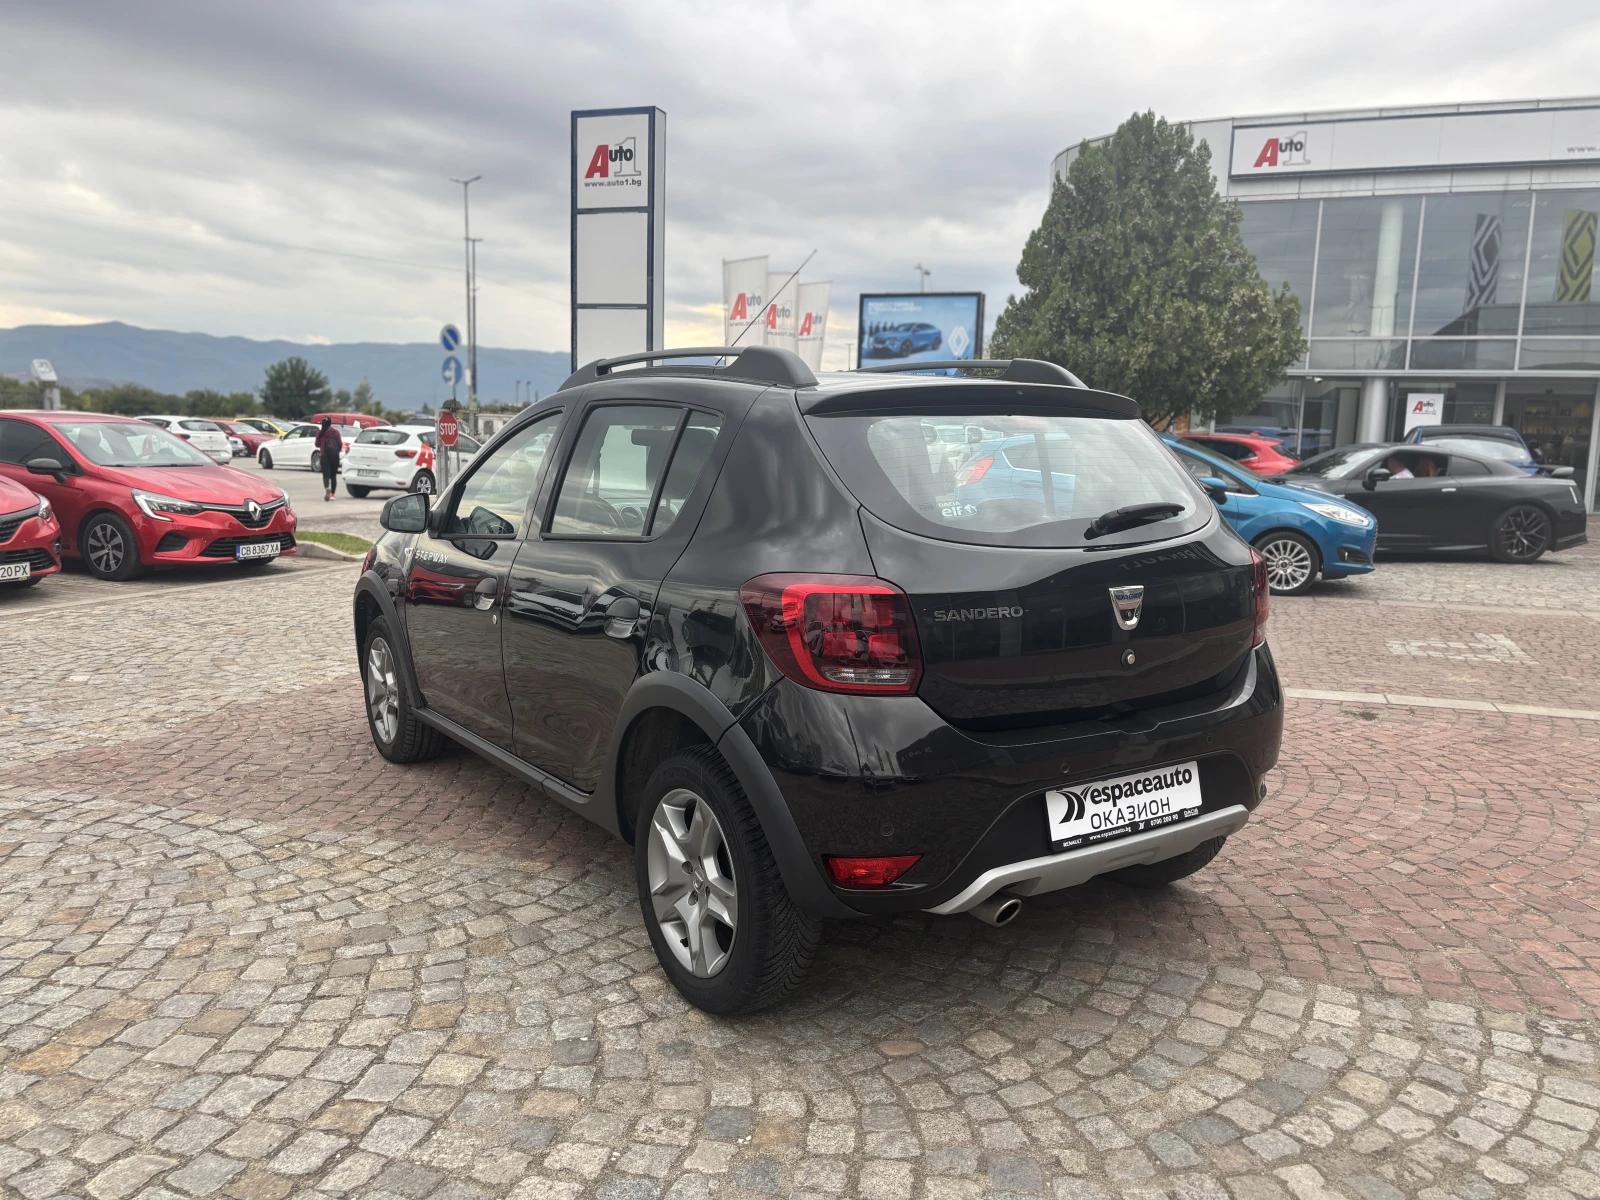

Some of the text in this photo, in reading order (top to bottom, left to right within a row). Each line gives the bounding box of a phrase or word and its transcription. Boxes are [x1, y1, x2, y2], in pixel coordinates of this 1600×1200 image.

[584, 178, 642, 188] www.auto1.bg
[439, 422, 457, 436] STOP
[941, 505, 964, 517] elf
[252, 544, 270, 555] 8387
[270, 543, 280, 553] XA
[415, 550, 450, 564] STEPWAY
[14, 565, 28, 576] PX
[934, 605, 1024, 622] SANDERO
[1090, 769, 1193, 807] espaceauto
[1090, 797, 1171, 830] ОКАЗИОН
[1062, 838, 1083, 848] RENAULT
[1089, 825, 1132, 842] www.espaceauto.bg
